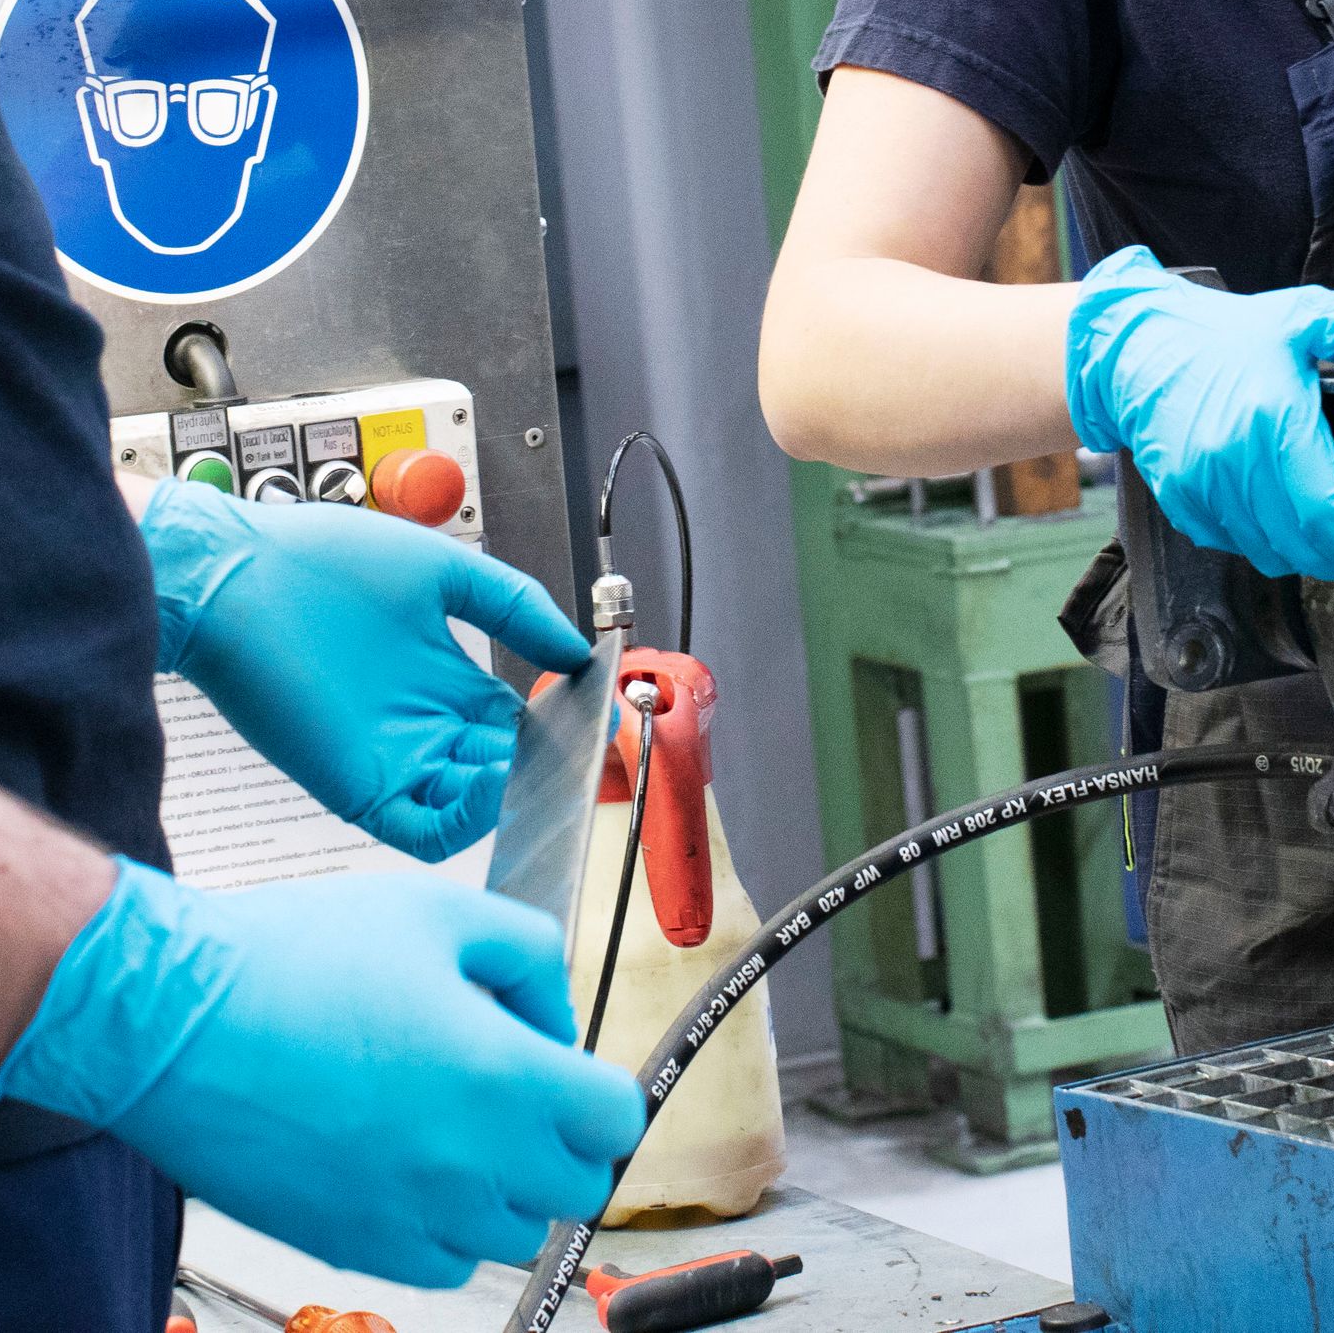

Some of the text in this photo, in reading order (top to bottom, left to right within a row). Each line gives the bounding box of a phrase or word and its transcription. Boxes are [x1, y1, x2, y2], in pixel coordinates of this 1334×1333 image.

[176, 412, 222, 429] Hydraulik
[373, 422, 413, 438] NOT-AUS
[1290, 755, 1323, 775] 2Q15
[651, 764, 1159, 1101] HANSA-FLEX KP 208 RM 08 WP 420 BAR MSHA IC-8/14 2Q15
[528, 1223, 592, 1333] HANSA-FLEX
